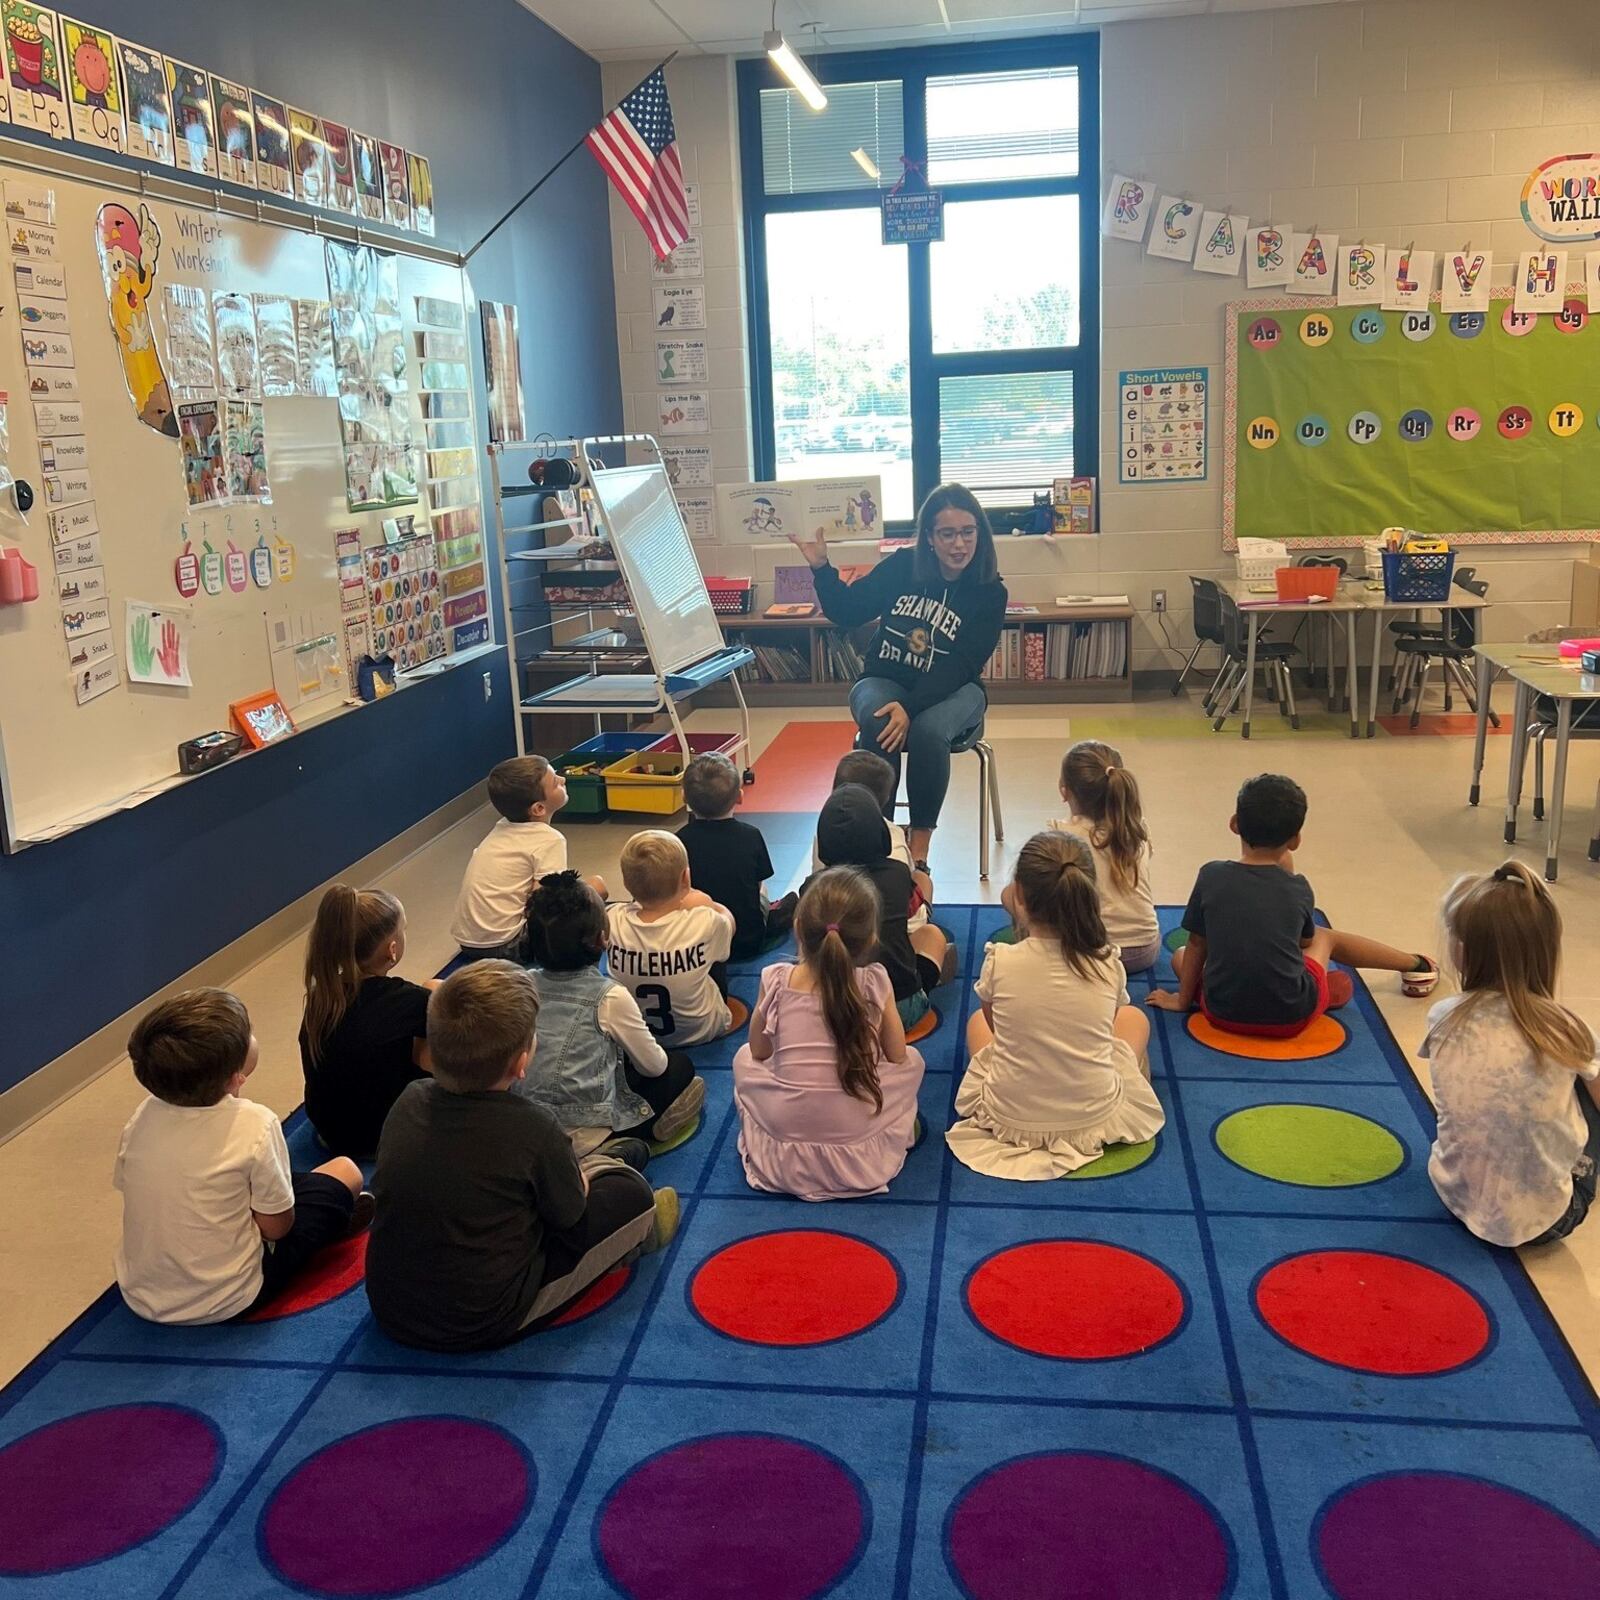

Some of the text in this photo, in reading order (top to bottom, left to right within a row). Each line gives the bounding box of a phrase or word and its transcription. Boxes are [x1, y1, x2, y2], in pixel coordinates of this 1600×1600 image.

[92, 107, 122, 153] Qq
[1540, 176, 1600, 201] WOR
[28, 229, 54, 244] Morning
[1115, 182, 1557, 293] R C A R A R L V H
[35, 245, 51, 256] Work
[36, 275, 63, 287] Calendar
[663, 289, 693, 297] Eagle Eye
[1253, 328, 1276, 341] Aa
[1306, 321, 1328, 337] Bb
[1358, 318, 1378, 334] Cc
[1408, 315, 1430, 332] Dd
[1457, 312, 1479, 329] Ee
[1560, 307, 1583, 328] Gg
[52, 344, 67, 354] Skills
[1126, 371, 1202, 384] Short Vowels
[54, 379, 72, 389] Lunch
[60, 413, 79, 423] Recess
[1252, 411, 1574, 439] Nn Oo Pp Qq Rr Ss Tt
[56, 445, 85, 455] Knowledge
[65, 481, 87, 491] Writing
[72, 515, 89, 526] Music
[77, 541, 91, 551] Read
[77, 554, 93, 565] Aloud
[84, 580, 99, 590] Math
[85, 610, 106, 621] Centers
[891, 595, 962, 641] SHAWNEE
[457, 629, 480, 646] December
[92, 643, 108, 655] Snack
[94, 669, 112, 682] Recess
[608, 942, 707, 977] ETTLEHAKE
[635, 983, 676, 1037] 3
